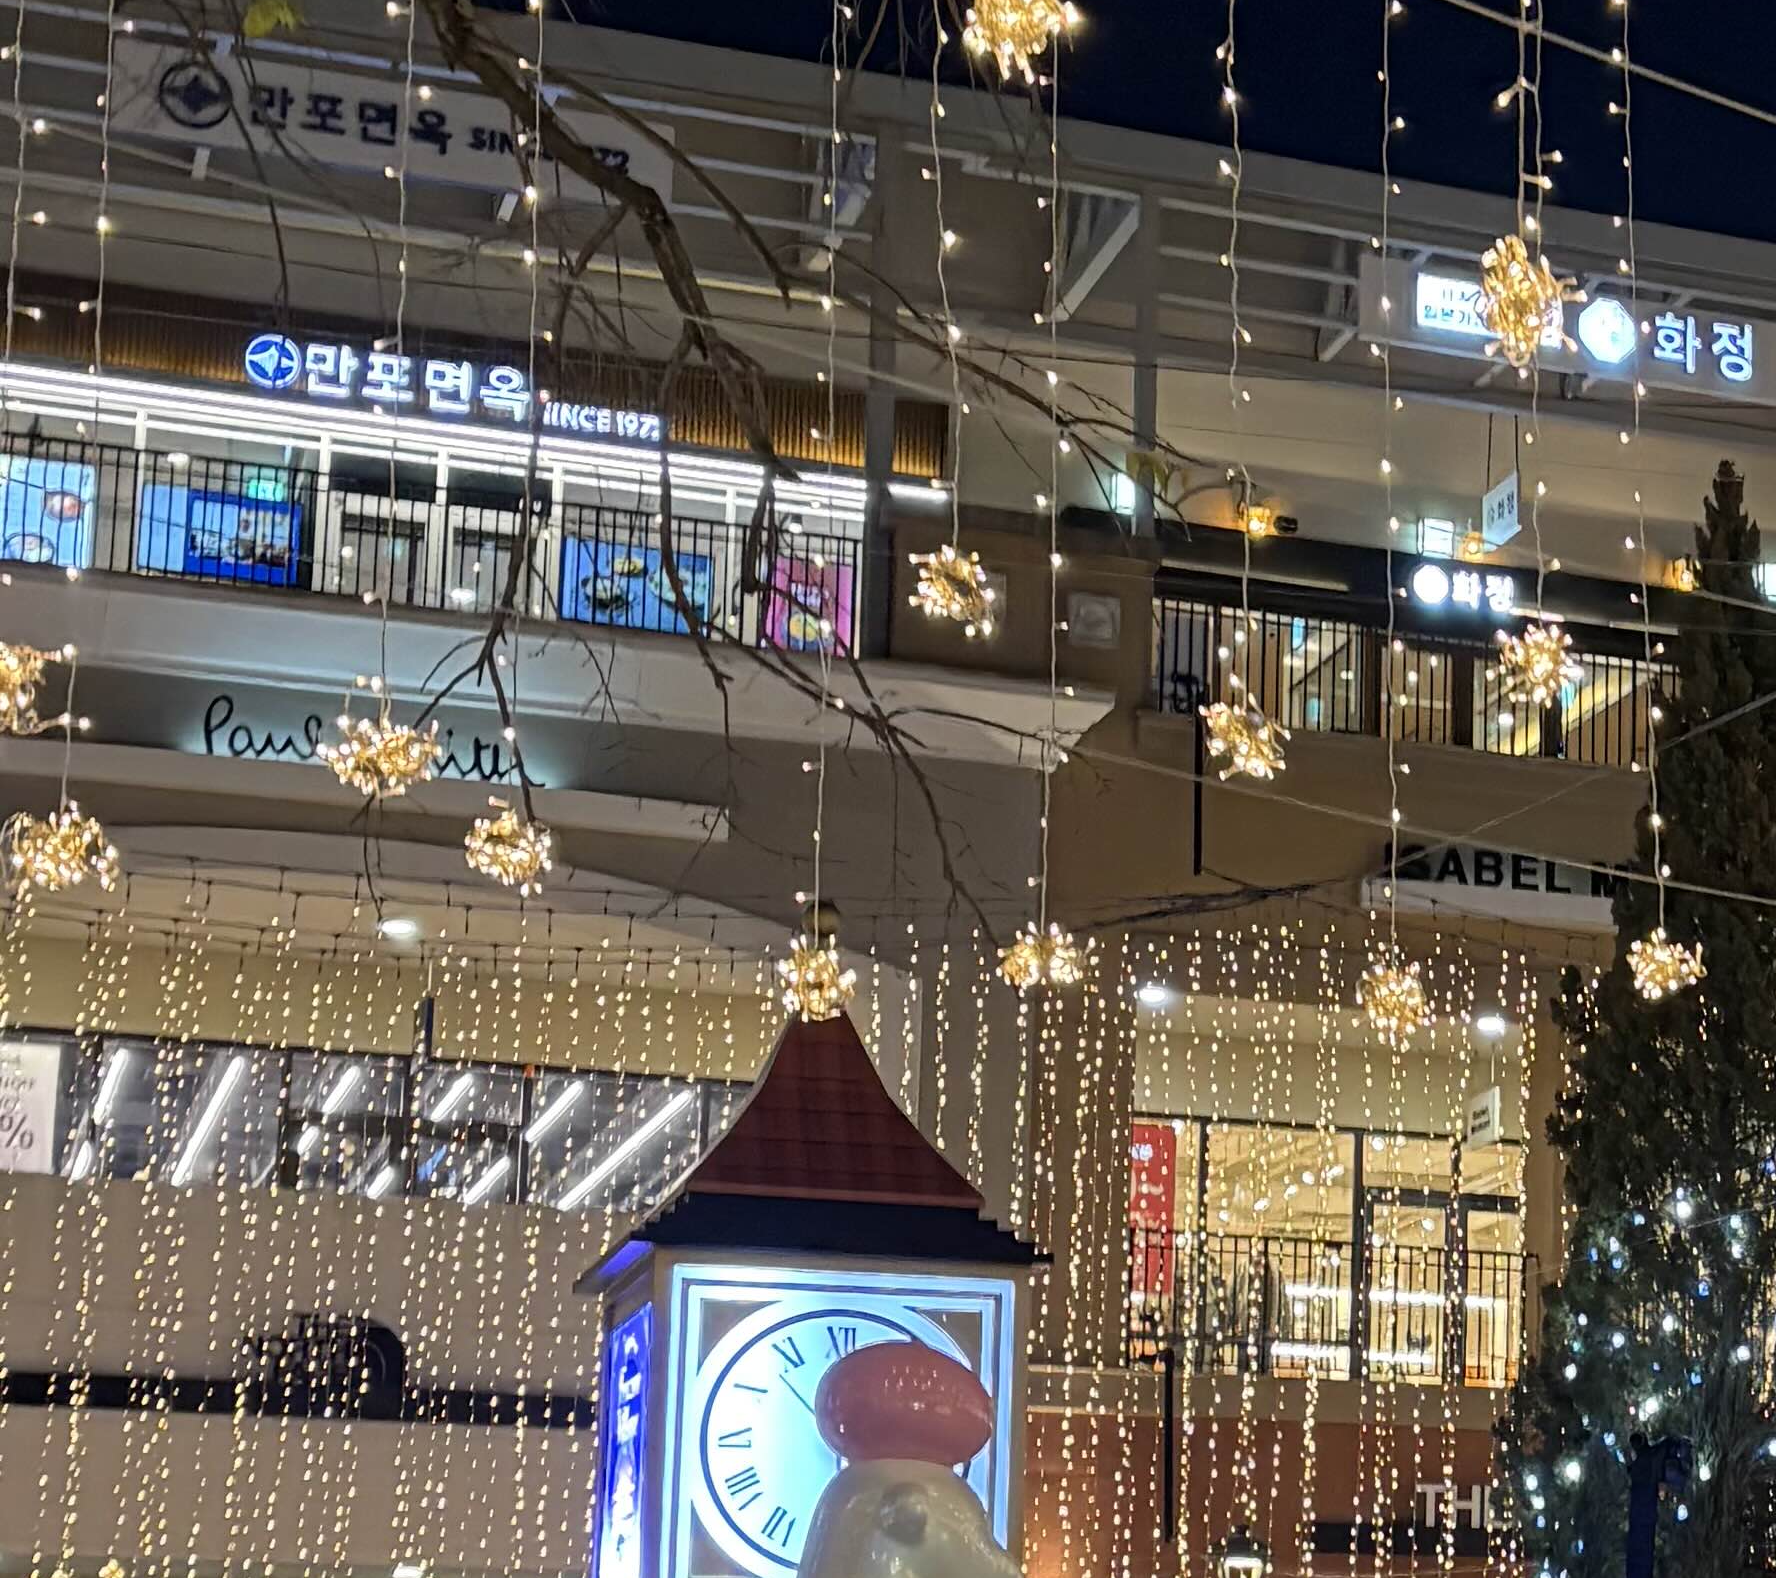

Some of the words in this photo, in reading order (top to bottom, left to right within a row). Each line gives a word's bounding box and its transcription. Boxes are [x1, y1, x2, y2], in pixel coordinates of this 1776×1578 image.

[250, 84, 451, 155] 만포면옥
[305, 342, 530, 422] 만포면옥
[1655, 312, 1754, 382] 화정
[1452, 570, 1514, 612] 화정
[204, 695, 322, 759] Paul
